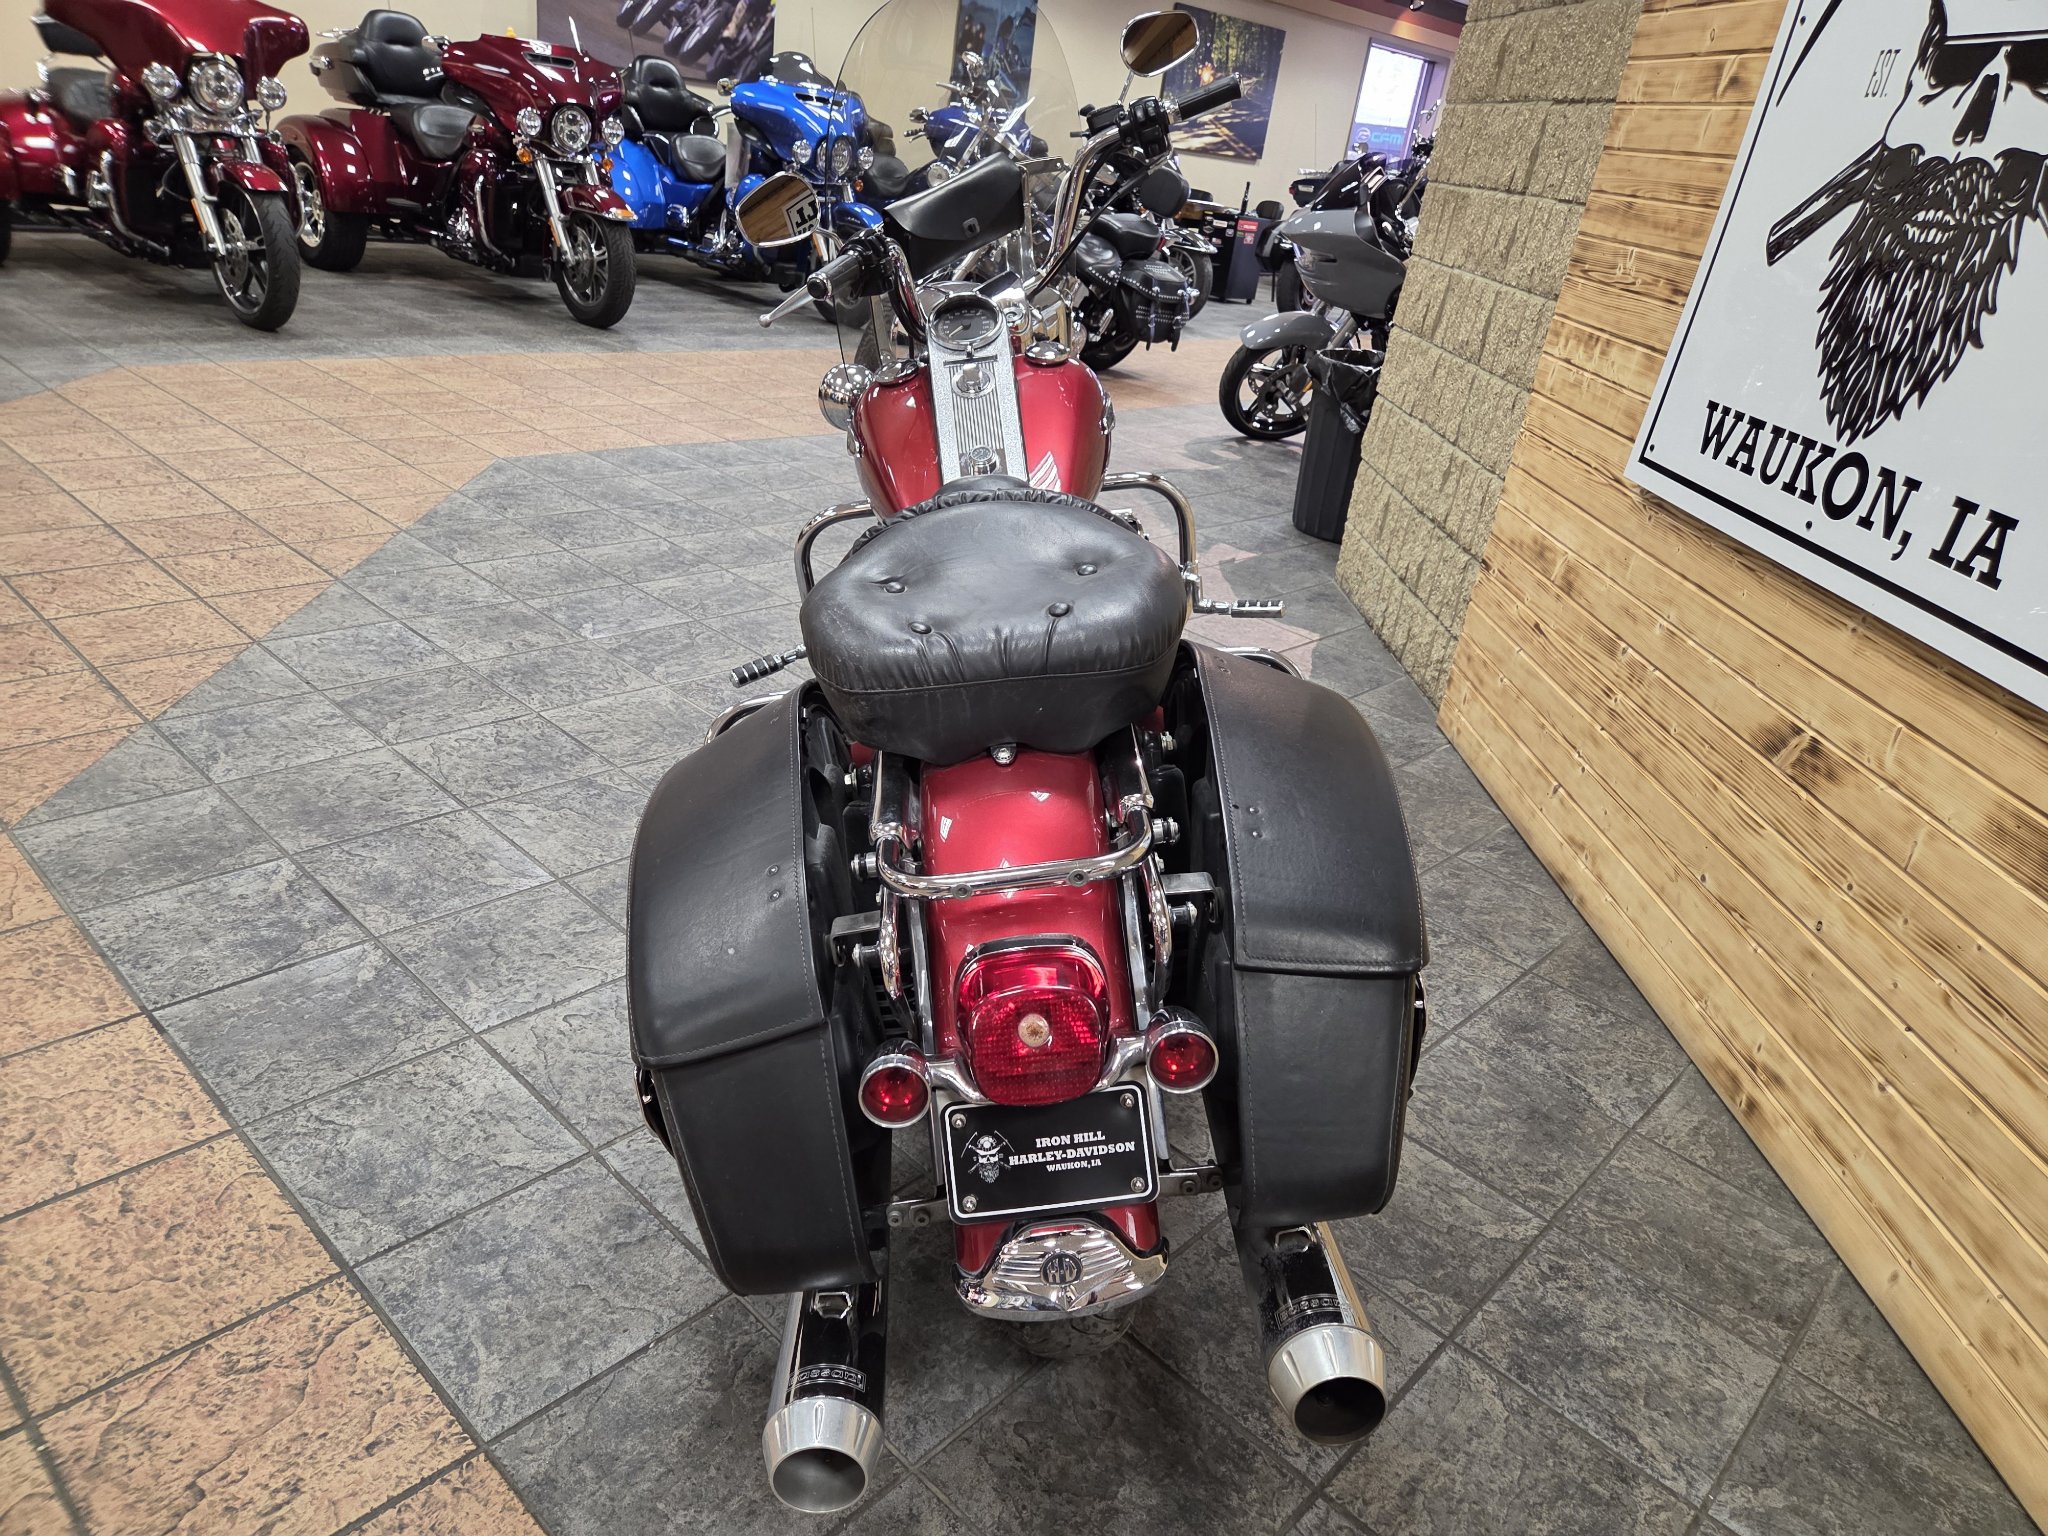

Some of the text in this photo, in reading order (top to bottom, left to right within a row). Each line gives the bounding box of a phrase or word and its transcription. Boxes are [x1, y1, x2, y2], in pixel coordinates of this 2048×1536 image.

[1700, 400, 2019, 590] WAUKON, IA
[1036, 1131, 1105, 1148] IRON HILL
[1009, 1141, 1135, 1165] HARLEY-DAVIDSON
